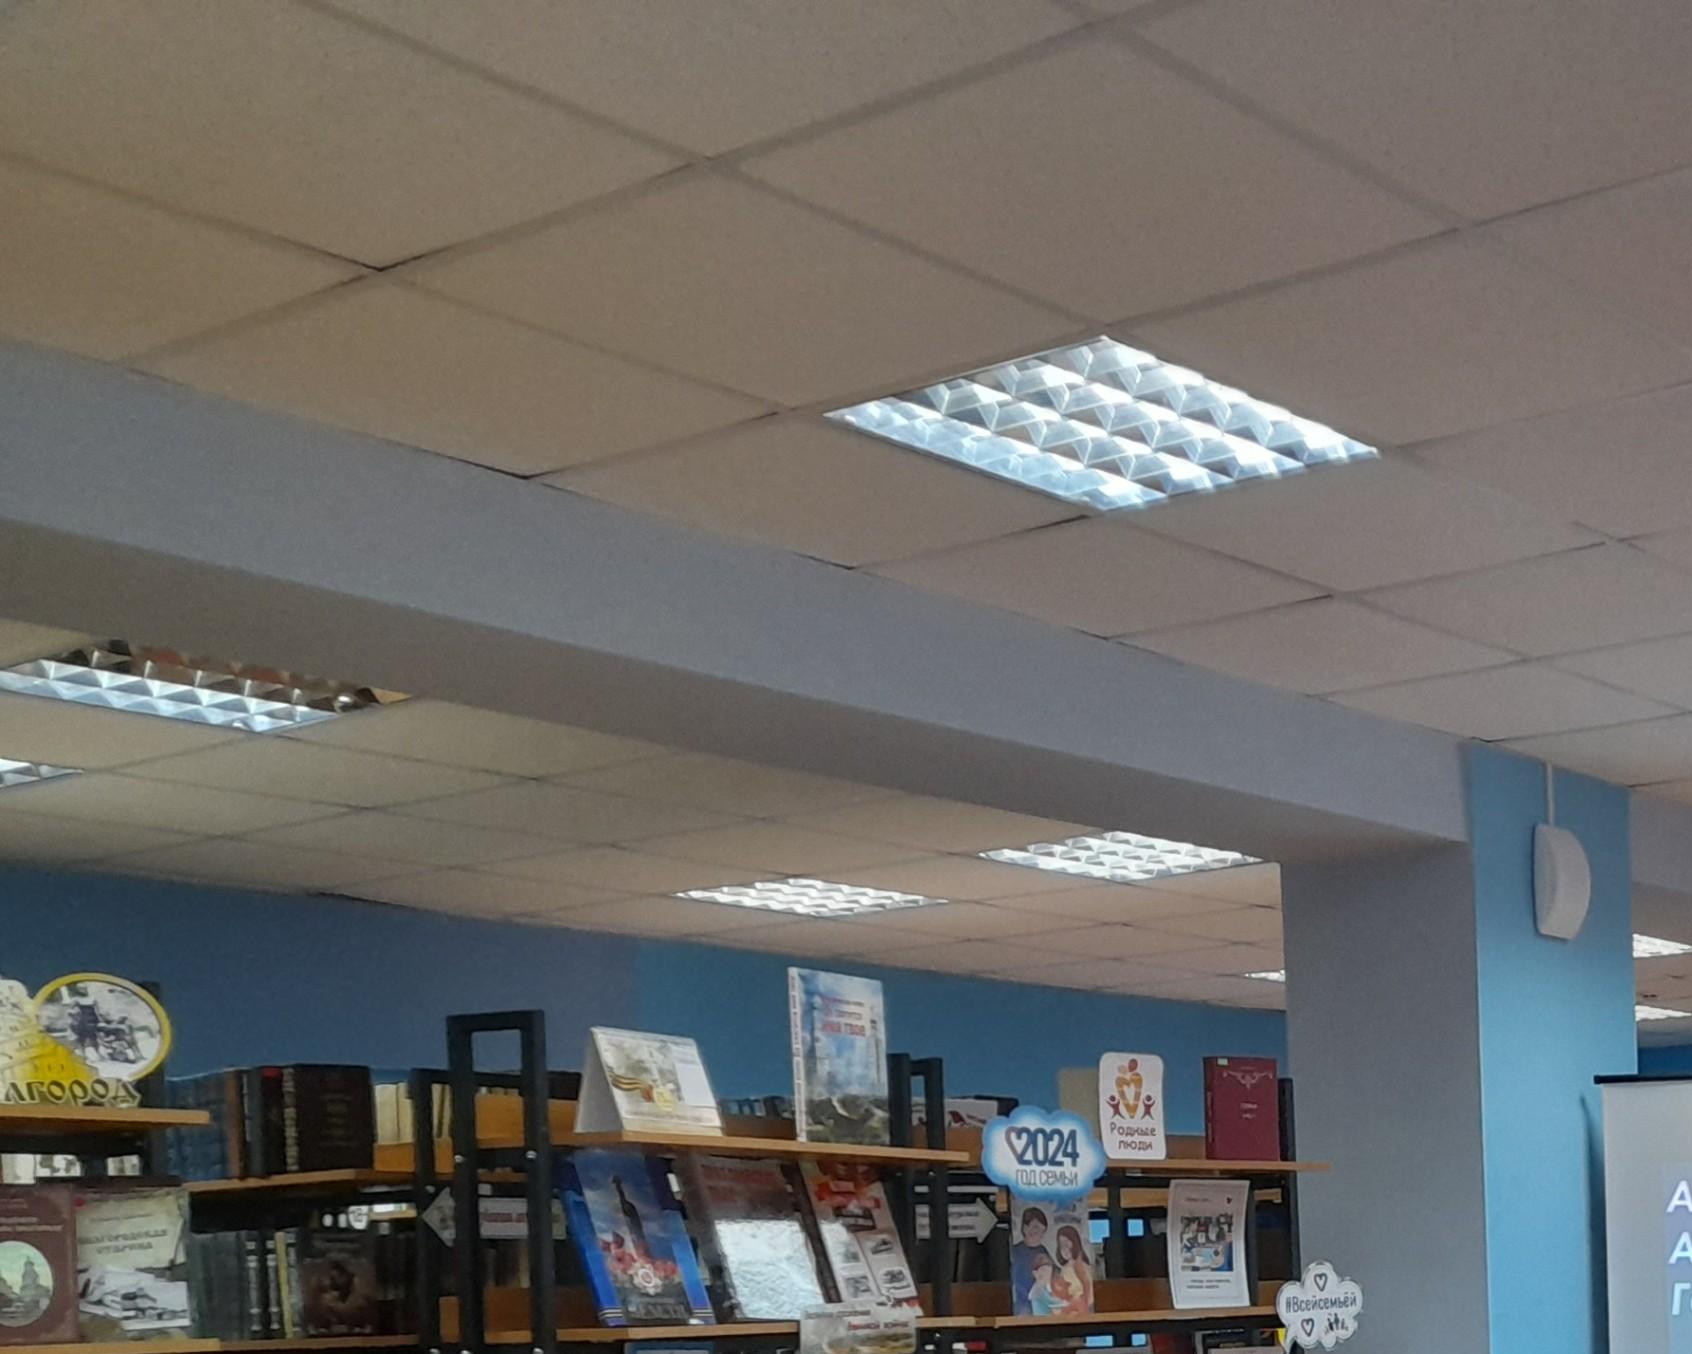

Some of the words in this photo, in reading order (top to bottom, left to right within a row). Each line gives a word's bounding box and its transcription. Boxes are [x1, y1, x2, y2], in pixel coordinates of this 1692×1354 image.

[1110, 1122, 1157, 1137] Родные
[1018, 1126, 1080, 1167] 2024
[1285, 1291, 1358, 1313] #Всейсемьёй
